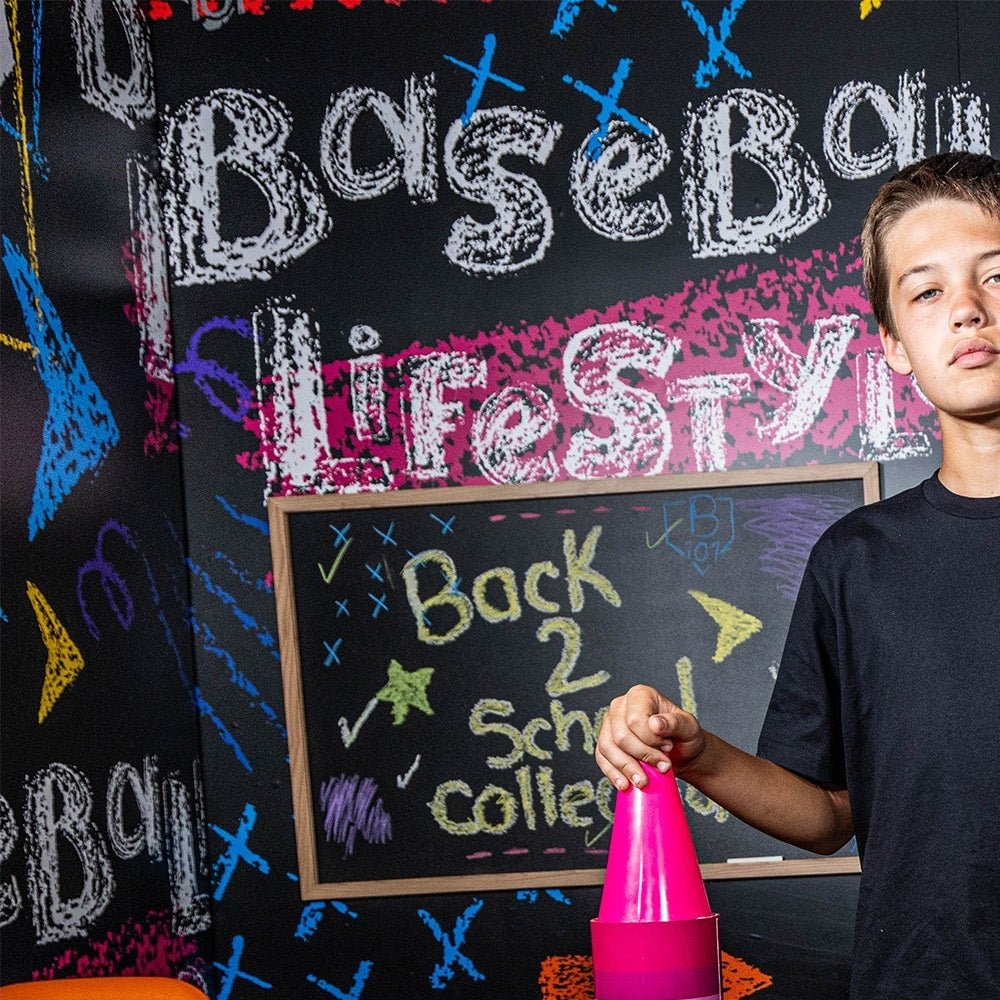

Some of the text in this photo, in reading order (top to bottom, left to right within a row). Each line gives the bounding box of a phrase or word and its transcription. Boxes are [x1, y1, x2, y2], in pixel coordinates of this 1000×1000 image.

[690, 493, 720, 538] B
[536, 616, 611, 697] 2
[469, 656, 697, 770] Schl
[426, 765, 729, 835] colle
